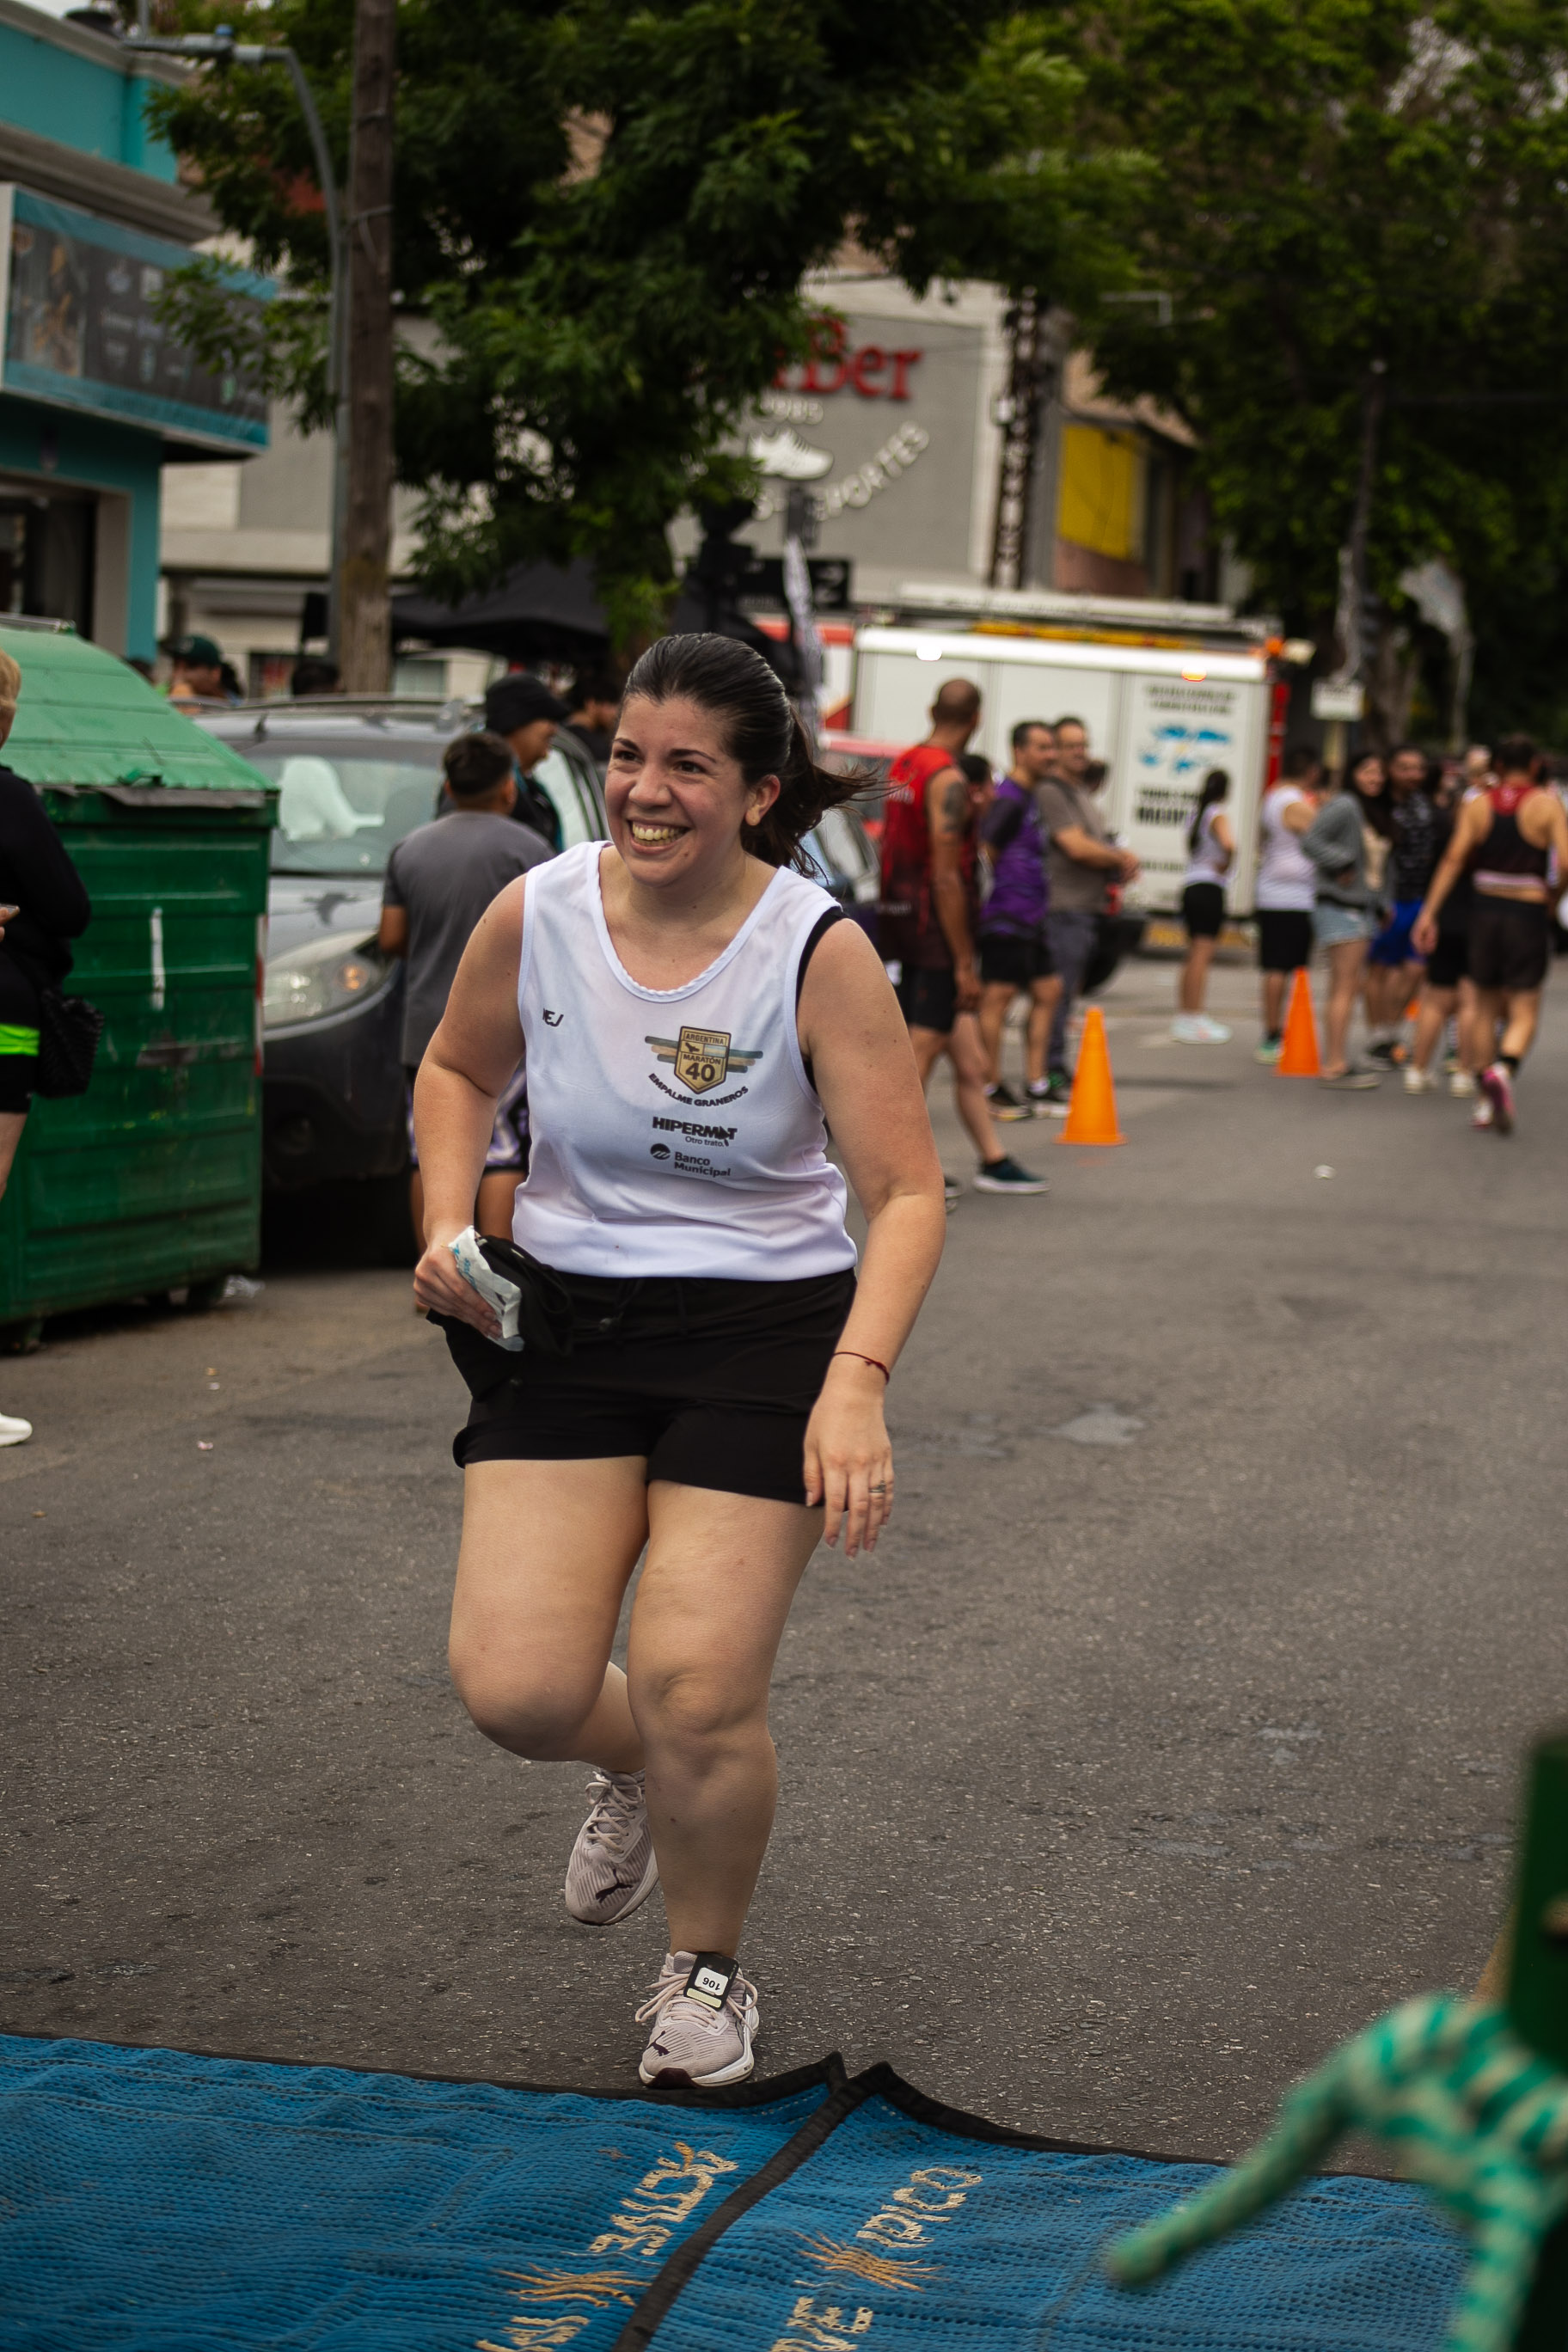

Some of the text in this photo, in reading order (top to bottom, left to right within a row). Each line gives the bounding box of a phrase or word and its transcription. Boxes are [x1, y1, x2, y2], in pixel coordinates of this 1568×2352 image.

[685, 1033, 724, 1045] ARGENTINA
[683, 1053, 720, 1065] MARATÓN
[685, 1063, 715, 1081] 40
[648, 1073, 749, 1107] EMPALME GRANEROS
[685, 1136, 703, 1145] Otro
[675, 1152, 711, 1167] Banco
[674, 1161, 732, 1178] Municipal
[702, 1977, 720, 1991] 106
[856, 2168, 984, 2248] IPICO
